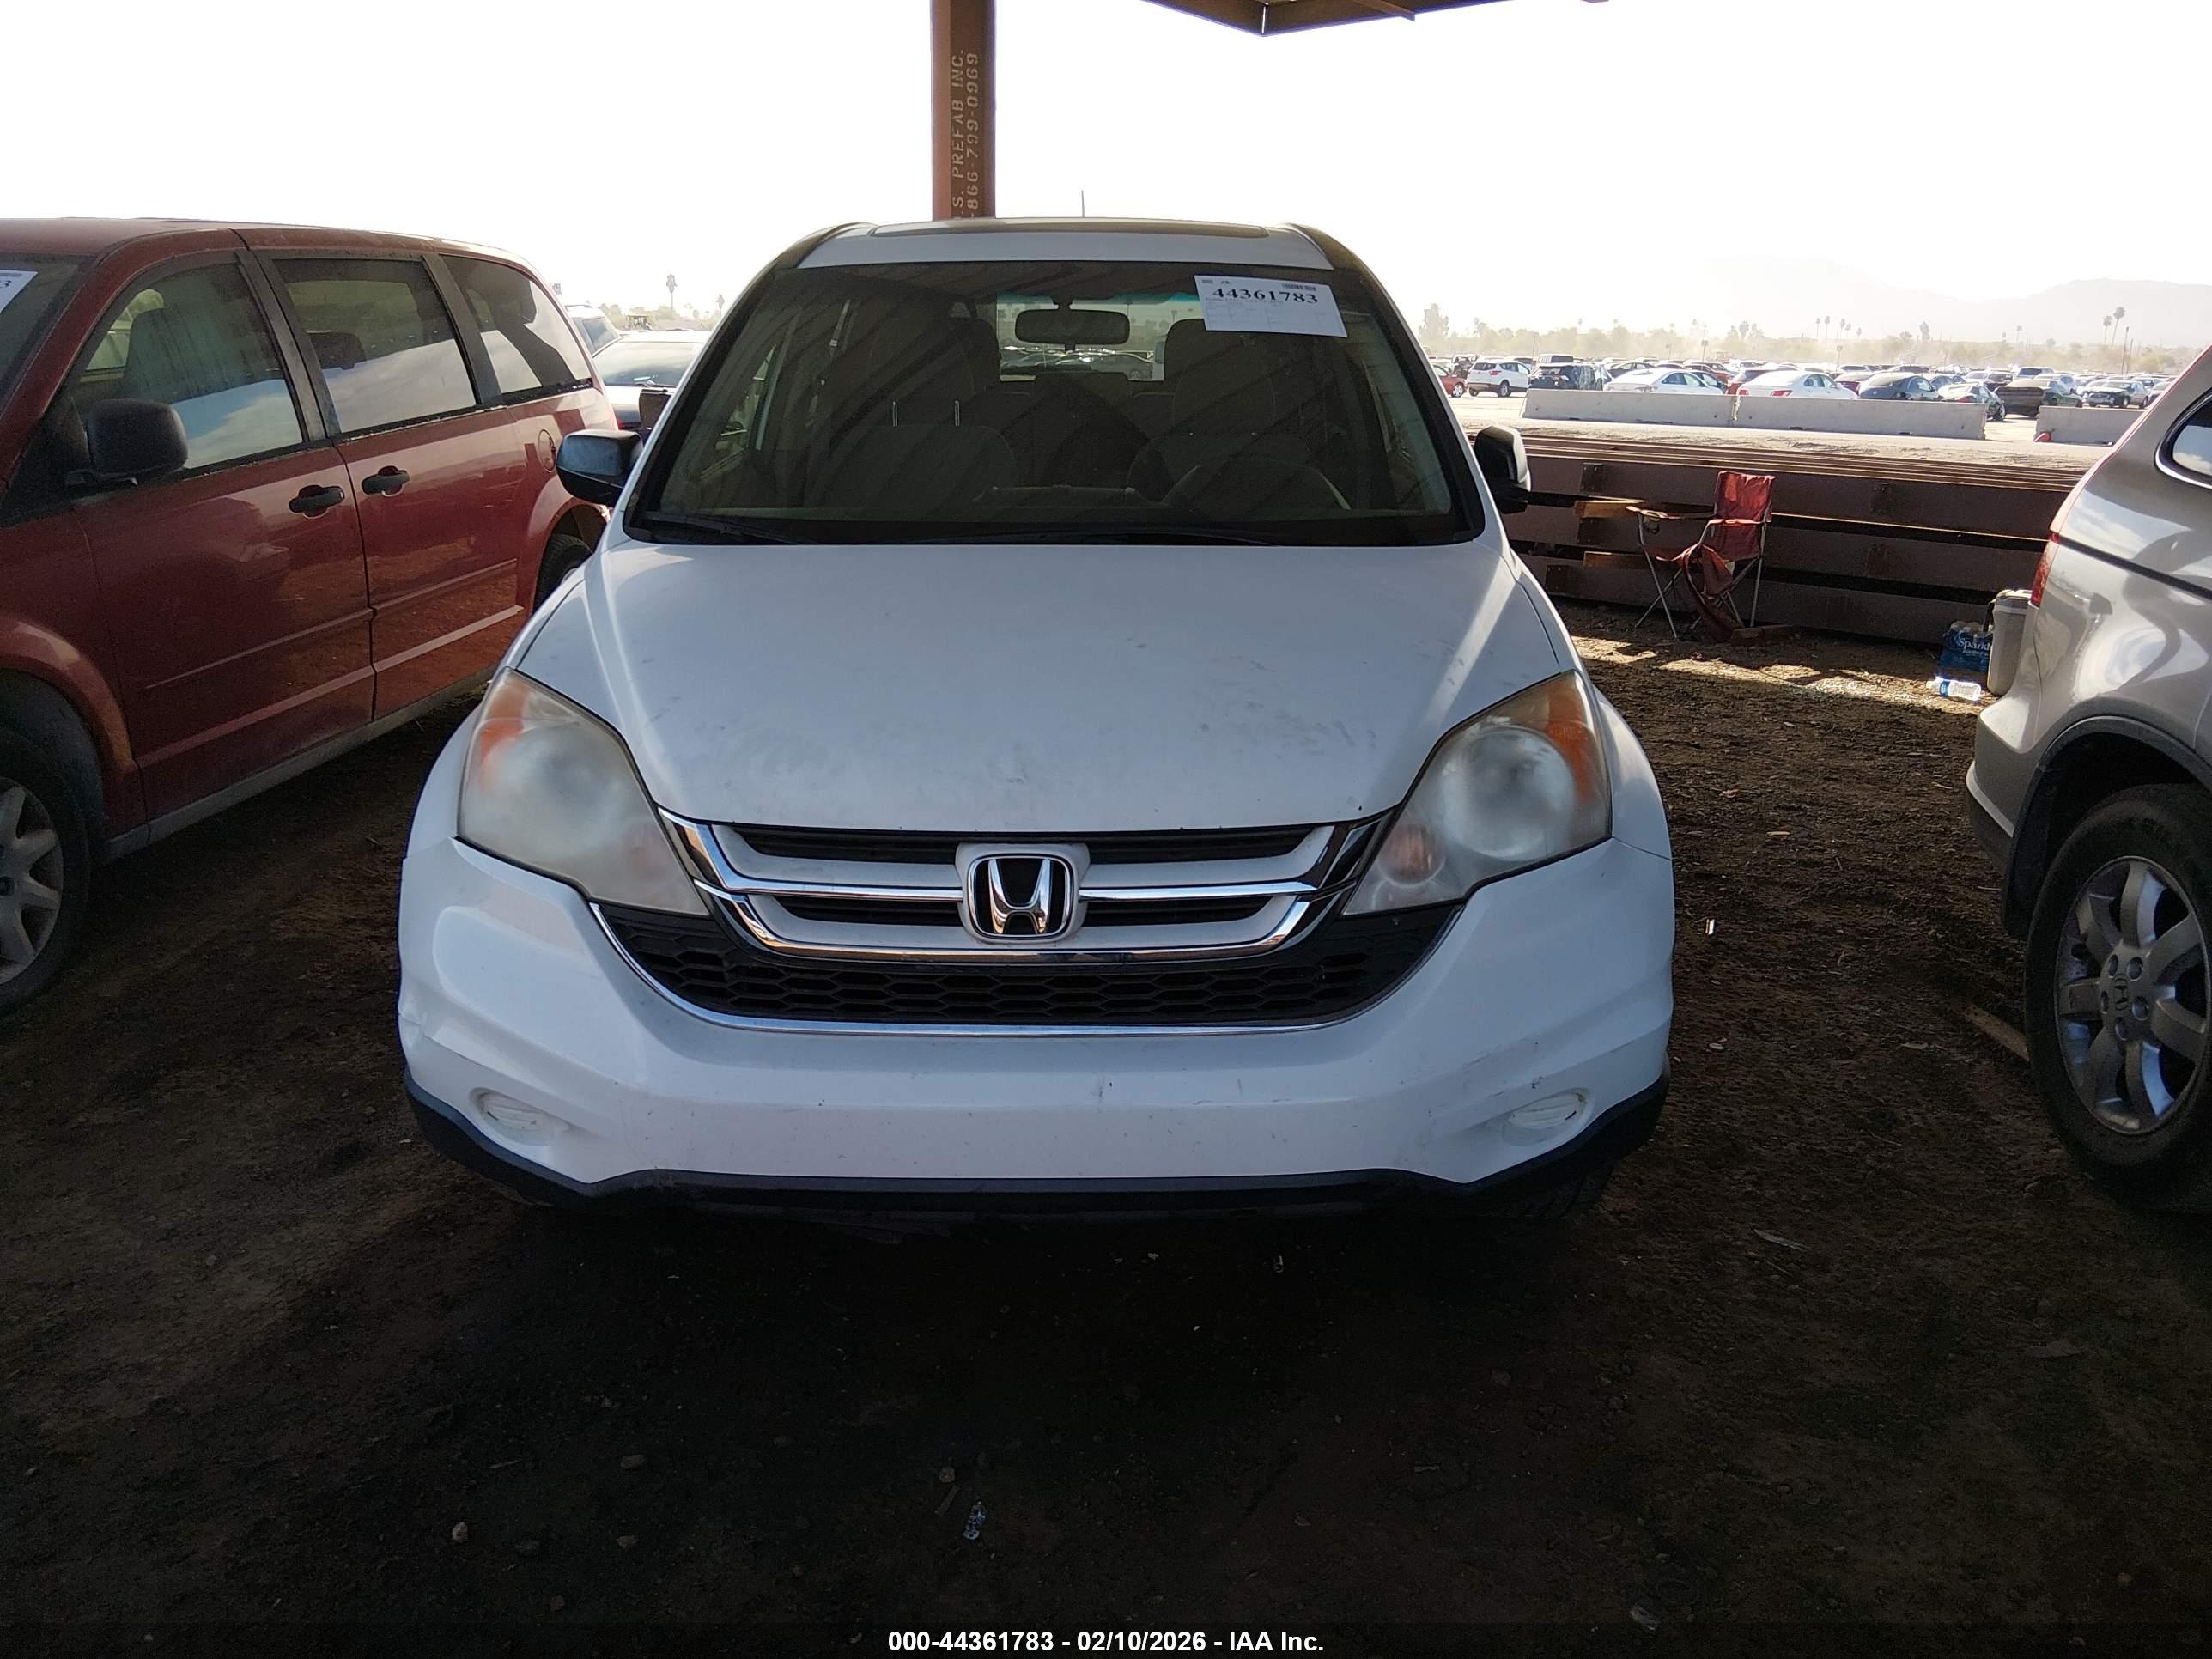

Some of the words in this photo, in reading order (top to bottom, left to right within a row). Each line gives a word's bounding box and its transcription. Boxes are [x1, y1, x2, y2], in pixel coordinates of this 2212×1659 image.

[951, 49, 964, 88] INC.
[951, 99, 964, 179] PREFAB
[1212, 288, 1319, 304] 44361783
